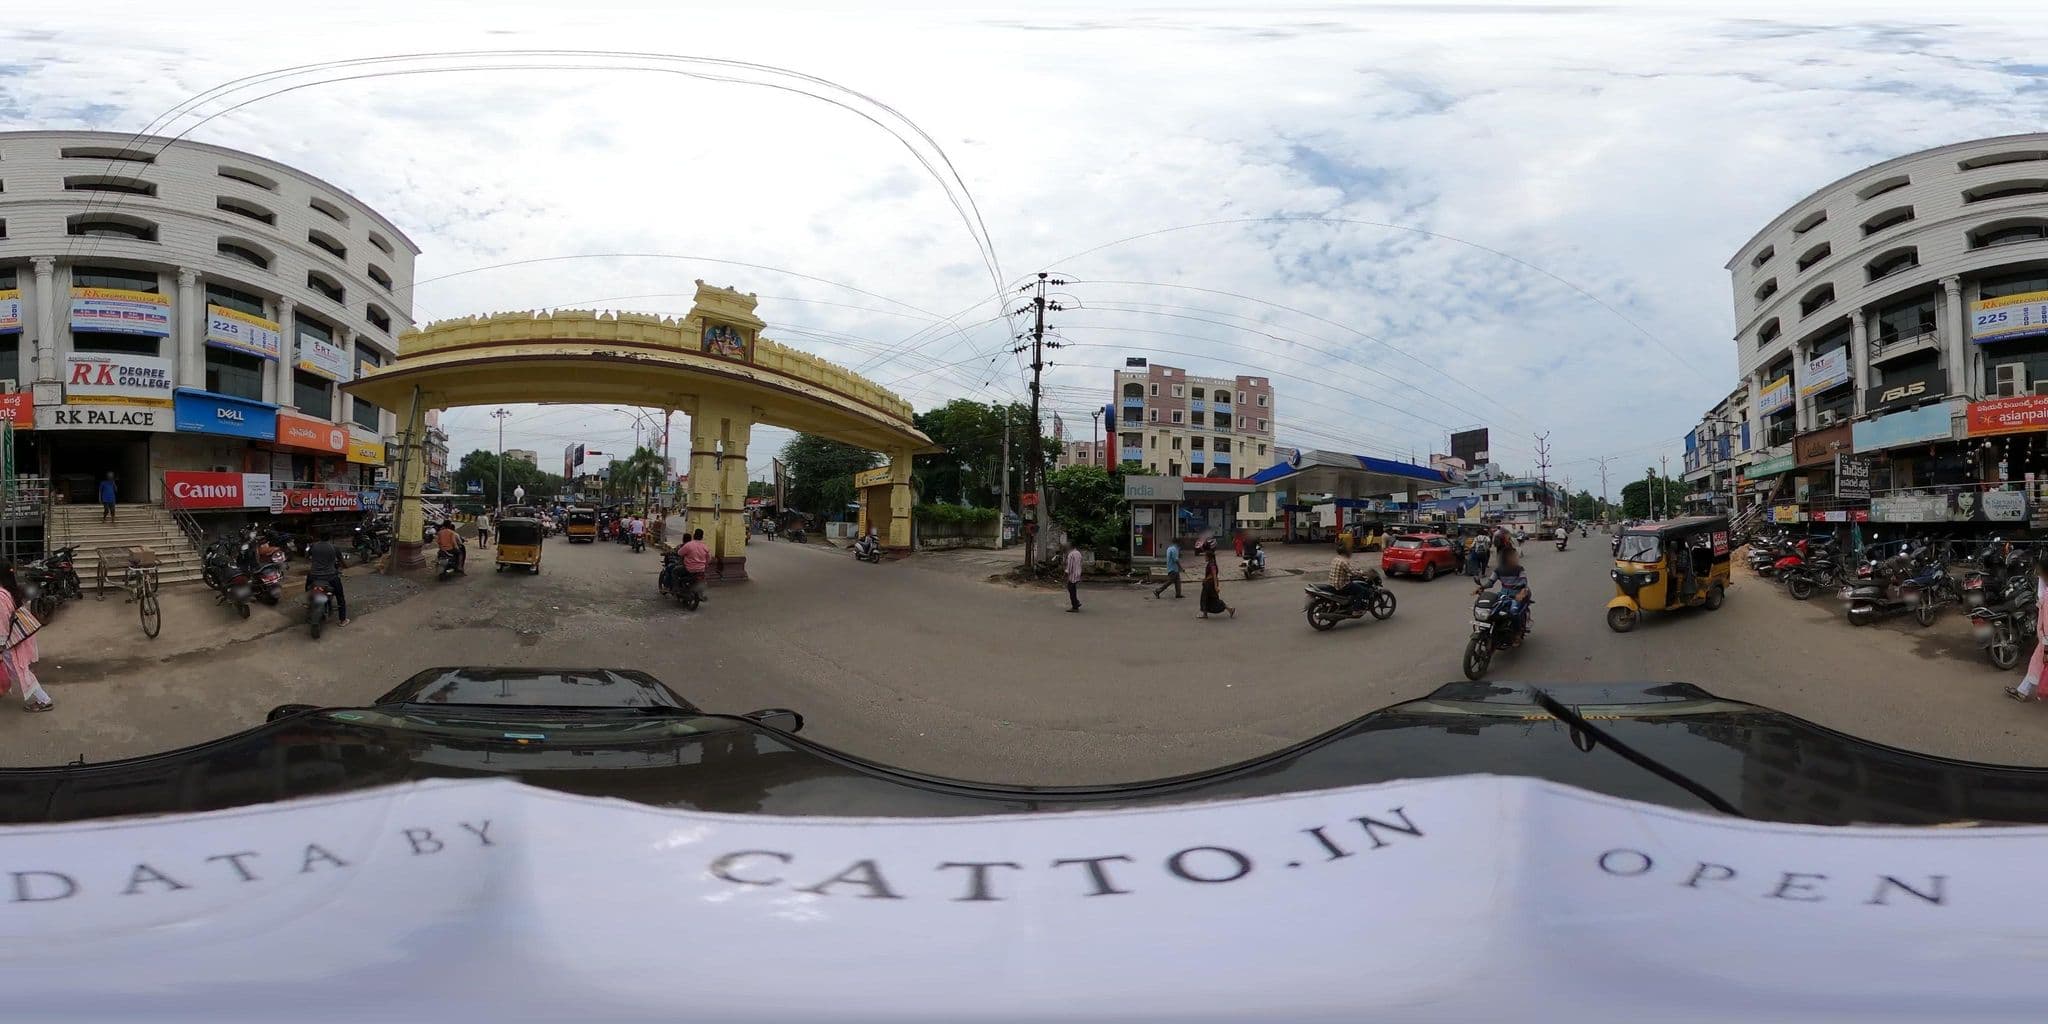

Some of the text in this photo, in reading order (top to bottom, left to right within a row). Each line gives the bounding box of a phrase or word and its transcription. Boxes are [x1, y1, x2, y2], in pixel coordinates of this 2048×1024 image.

[1978, 312, 2008, 325] 225
[213, 320, 239, 334] 225
[68, 363, 165, 386] RK DEGREE
[119, 376, 171, 389] COLLEGE
[1880, 381, 1926, 403] ASUS
[55, 410, 154, 426] RK PALACE
[217, 408, 244, 421] DELL
[173, 482, 237, 498] Canon
[8, 805, 1427, 903] DATA BY CATTO.IN
[1597, 847, 1951, 906] OPEN
